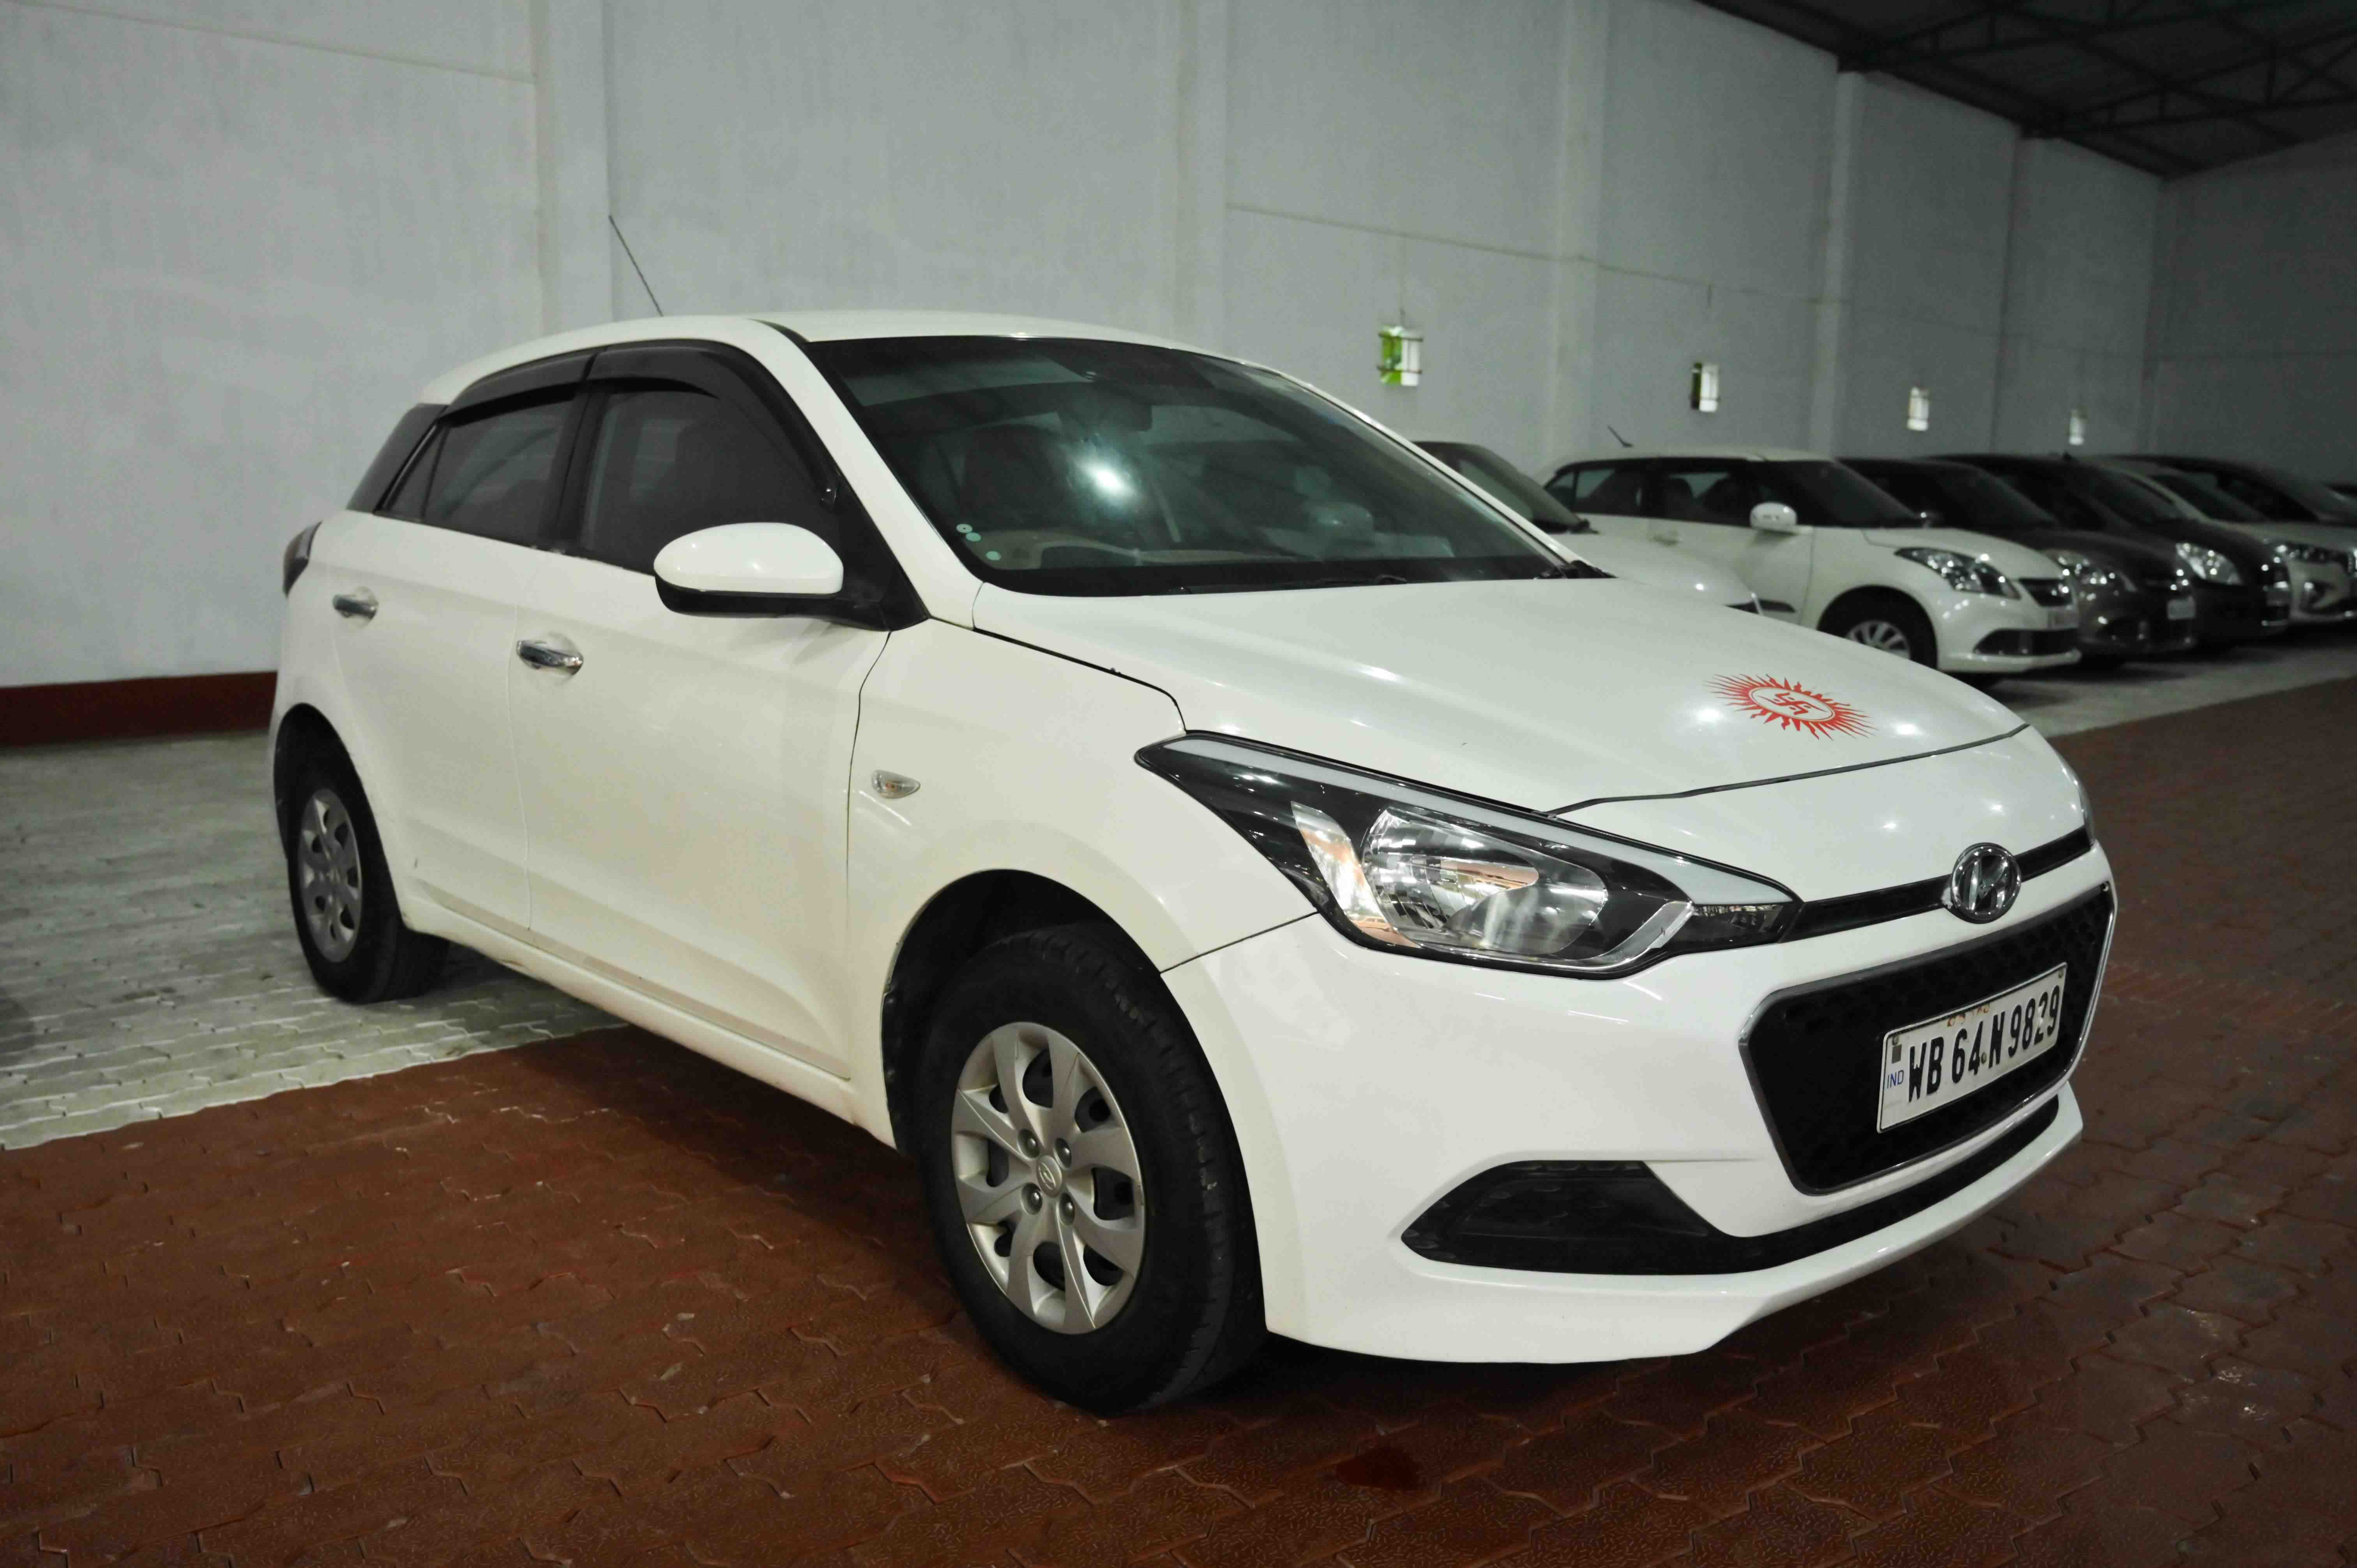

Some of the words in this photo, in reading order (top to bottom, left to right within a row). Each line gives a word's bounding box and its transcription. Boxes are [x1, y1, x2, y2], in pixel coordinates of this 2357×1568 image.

[1908, 1037, 1944, 1103] WB
[1952, 1020, 1983, 1084] 64
[2008, 985, 2060, 1058] 9829
[1887, 1070, 1905, 1089] IND
